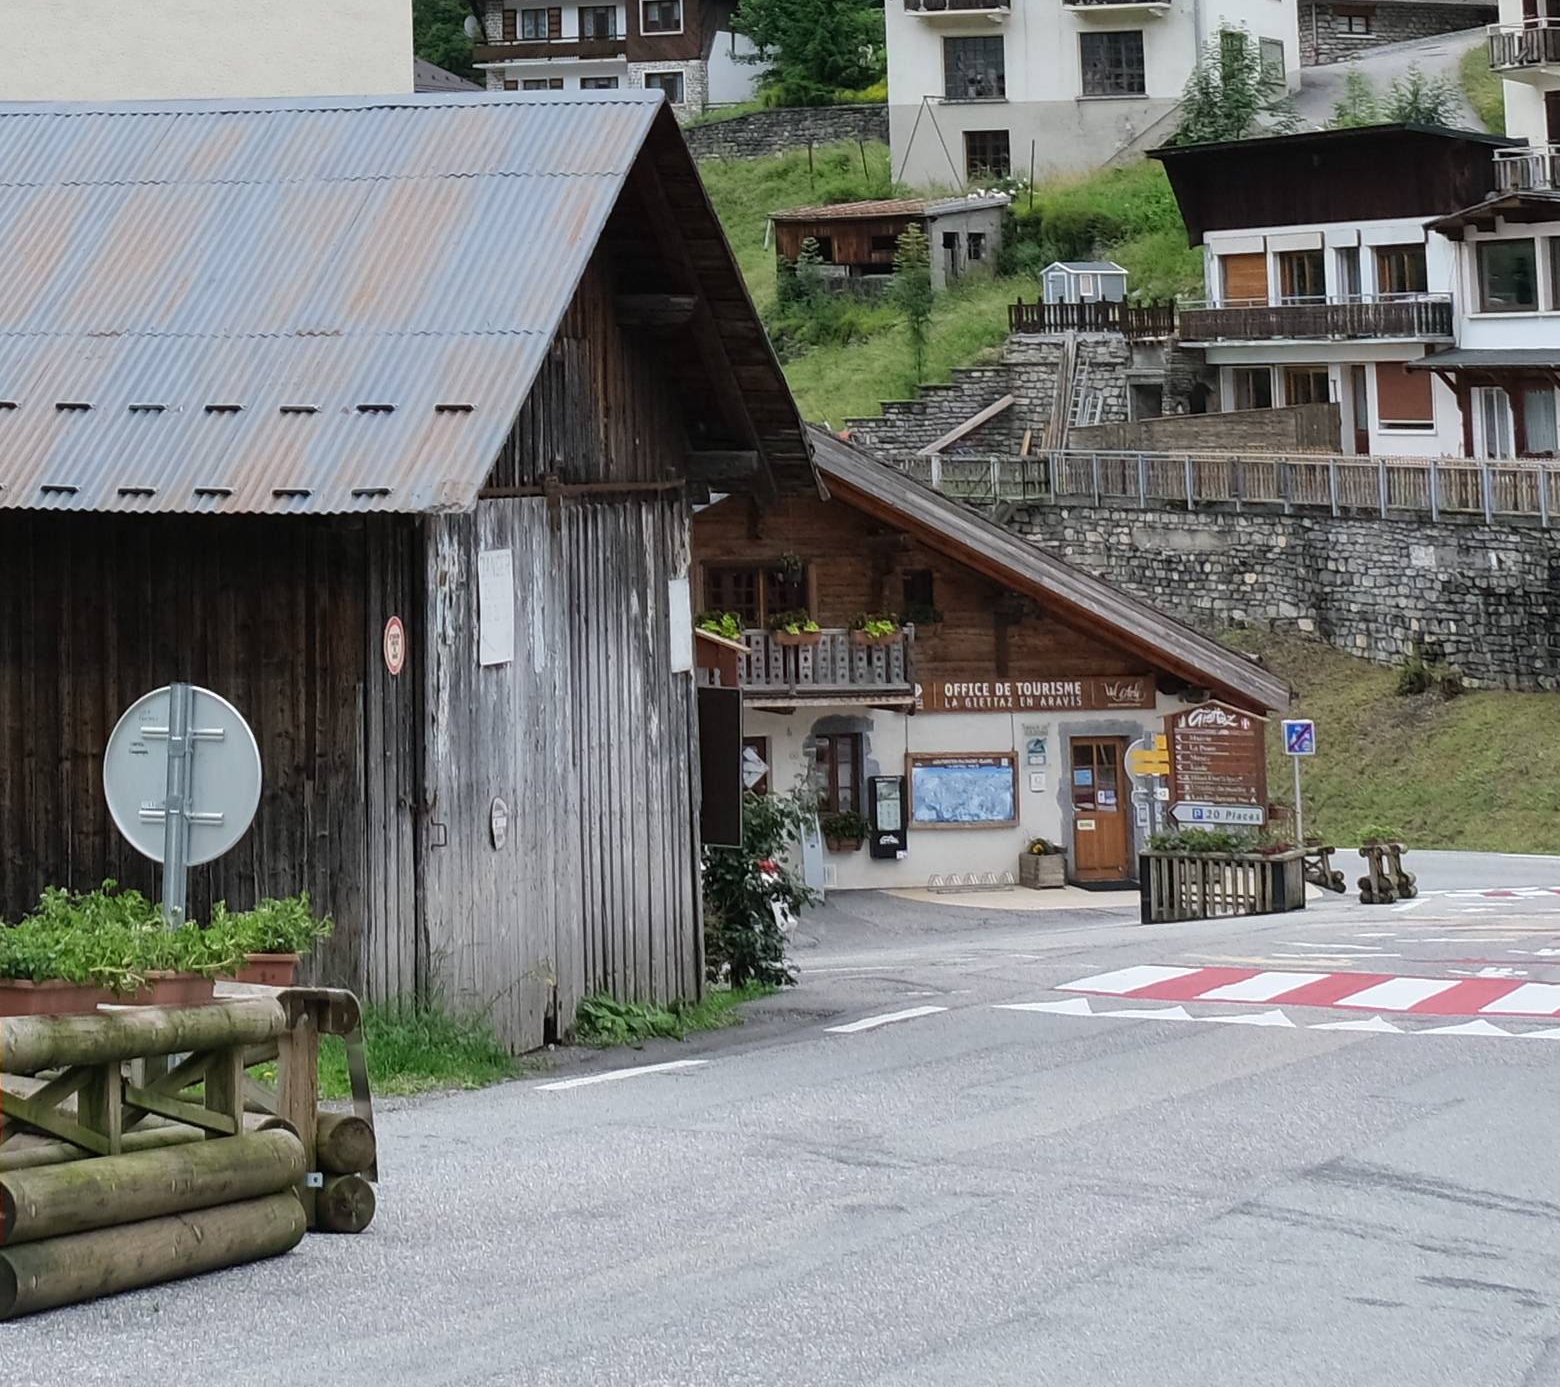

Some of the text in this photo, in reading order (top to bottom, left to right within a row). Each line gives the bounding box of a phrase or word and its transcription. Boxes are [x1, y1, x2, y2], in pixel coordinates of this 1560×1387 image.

[944, 681, 1082, 697] OFFICE DE TOURISME
[944, 696, 1082, 708] LA GIETTAZ EN ARAVIS
[1206, 809, 1220, 820] 20
